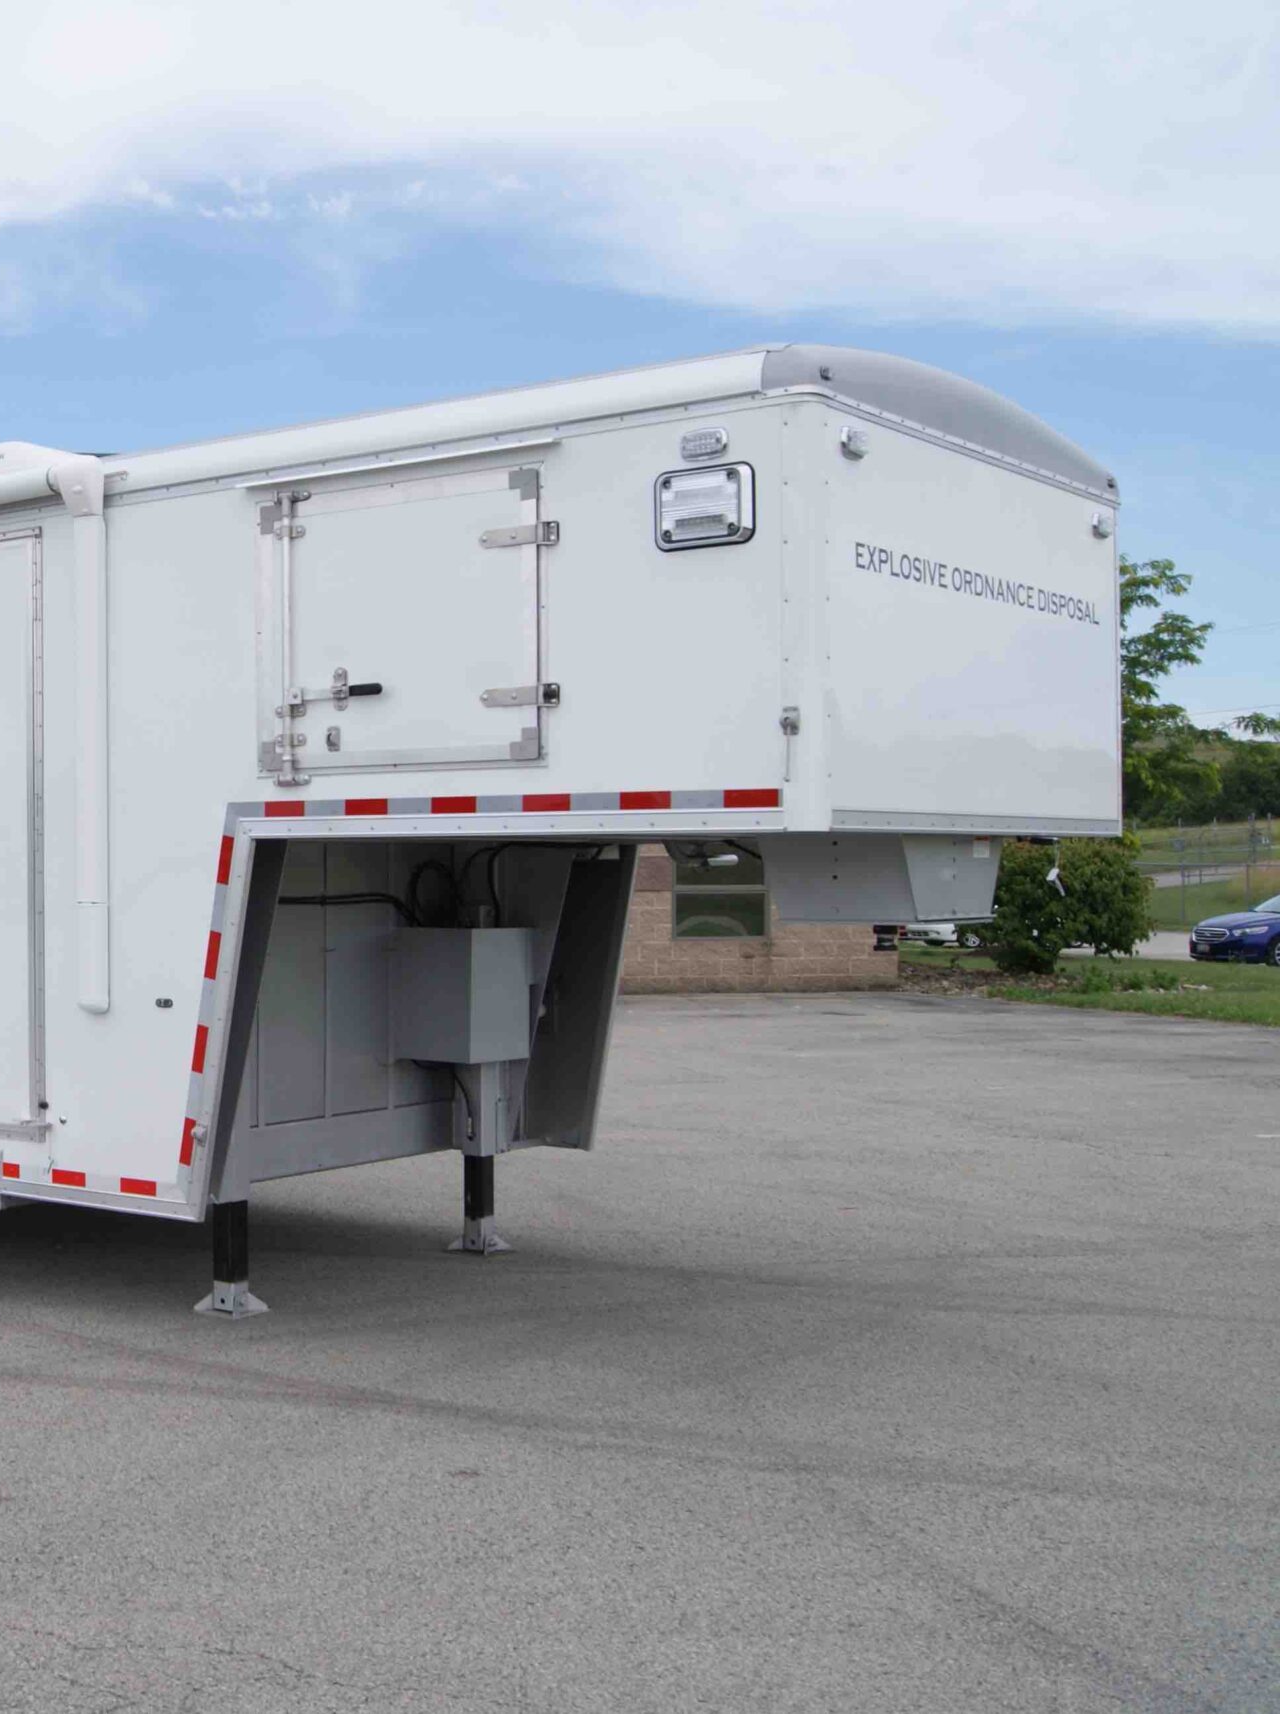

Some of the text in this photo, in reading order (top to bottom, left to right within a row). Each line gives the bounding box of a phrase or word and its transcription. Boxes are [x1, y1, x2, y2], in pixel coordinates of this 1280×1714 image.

[855, 541, 1100, 625] EXPLOSIVE ORDNANCE DISPOSAL
